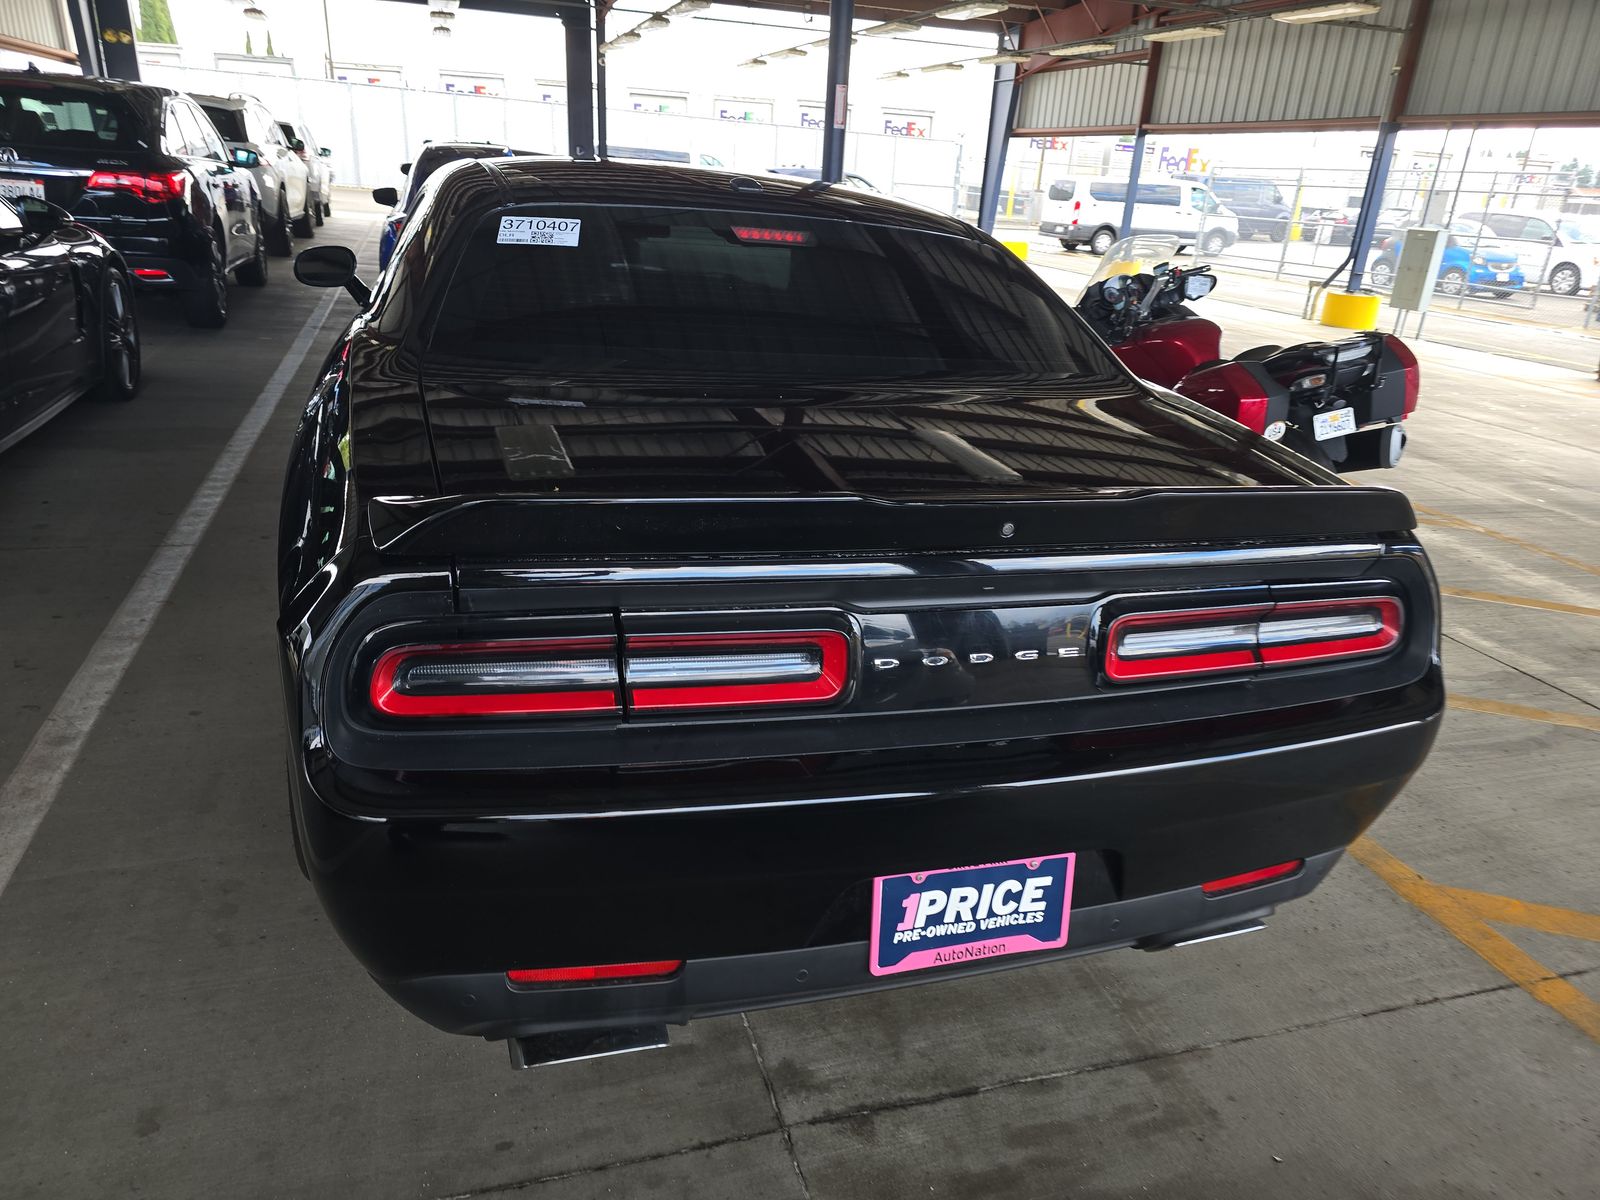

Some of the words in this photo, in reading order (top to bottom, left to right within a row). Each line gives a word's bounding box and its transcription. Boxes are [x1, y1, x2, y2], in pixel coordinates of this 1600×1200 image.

[884, 120, 926, 137] FedEx
[1158, 146, 1211, 174] FedEx
[502, 219, 579, 232] 3710407
[874, 647, 1080, 669] DODGE
[893, 921, 976, 944] PRE-OWNED
[980, 911, 1045, 931] VEHICLES
[933, 942, 1006, 964] AutoNation
